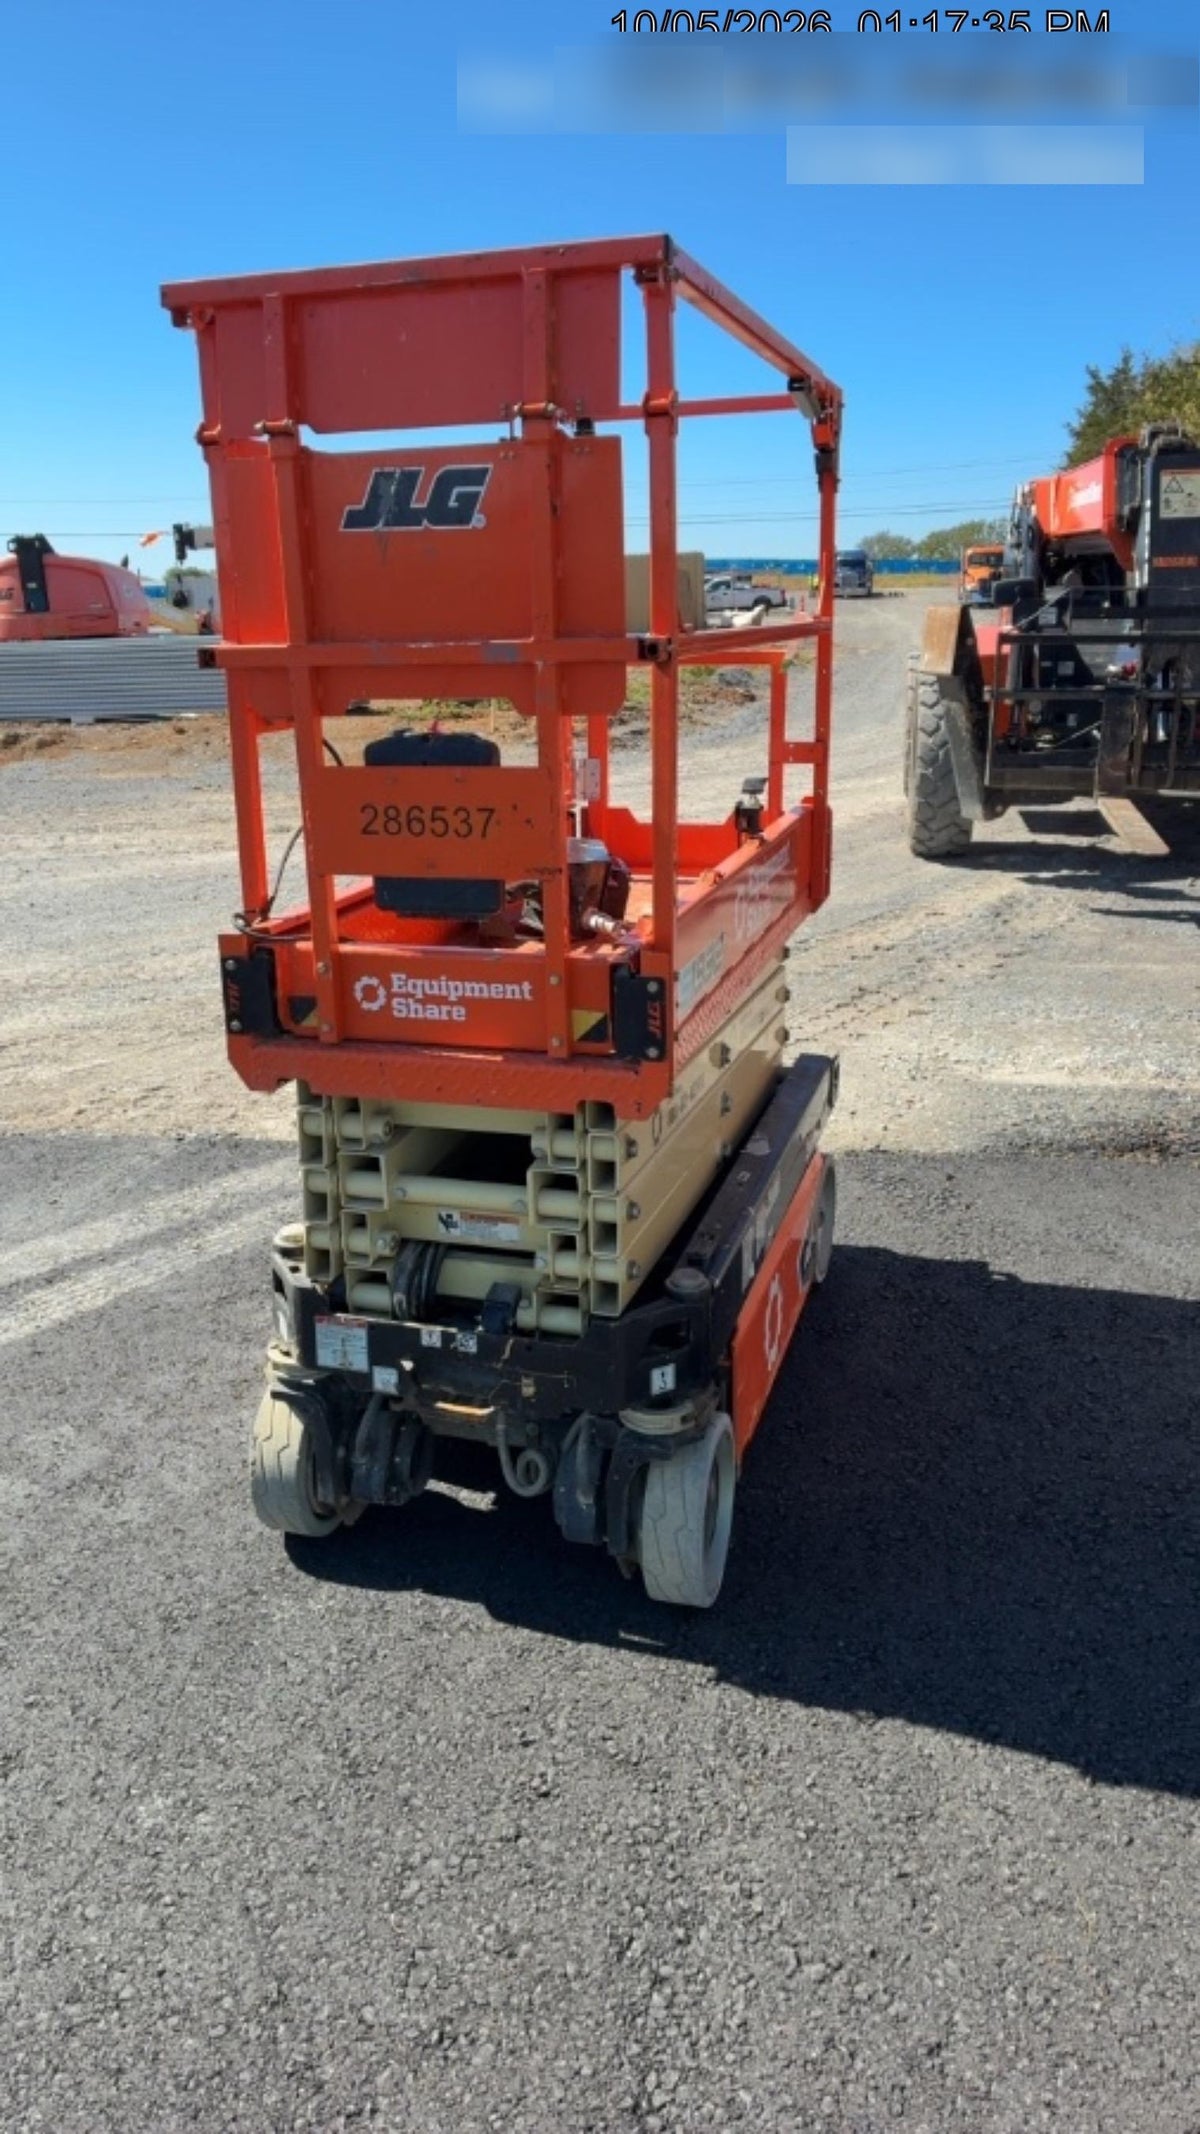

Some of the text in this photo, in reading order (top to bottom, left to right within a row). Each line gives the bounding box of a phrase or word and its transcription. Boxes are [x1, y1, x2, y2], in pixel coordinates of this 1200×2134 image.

[339, 464, 493, 531] JLG
[360, 804, 496, 838] 286537
[390, 973, 533, 1001] Equipment
[391, 998, 467, 1021] Share
